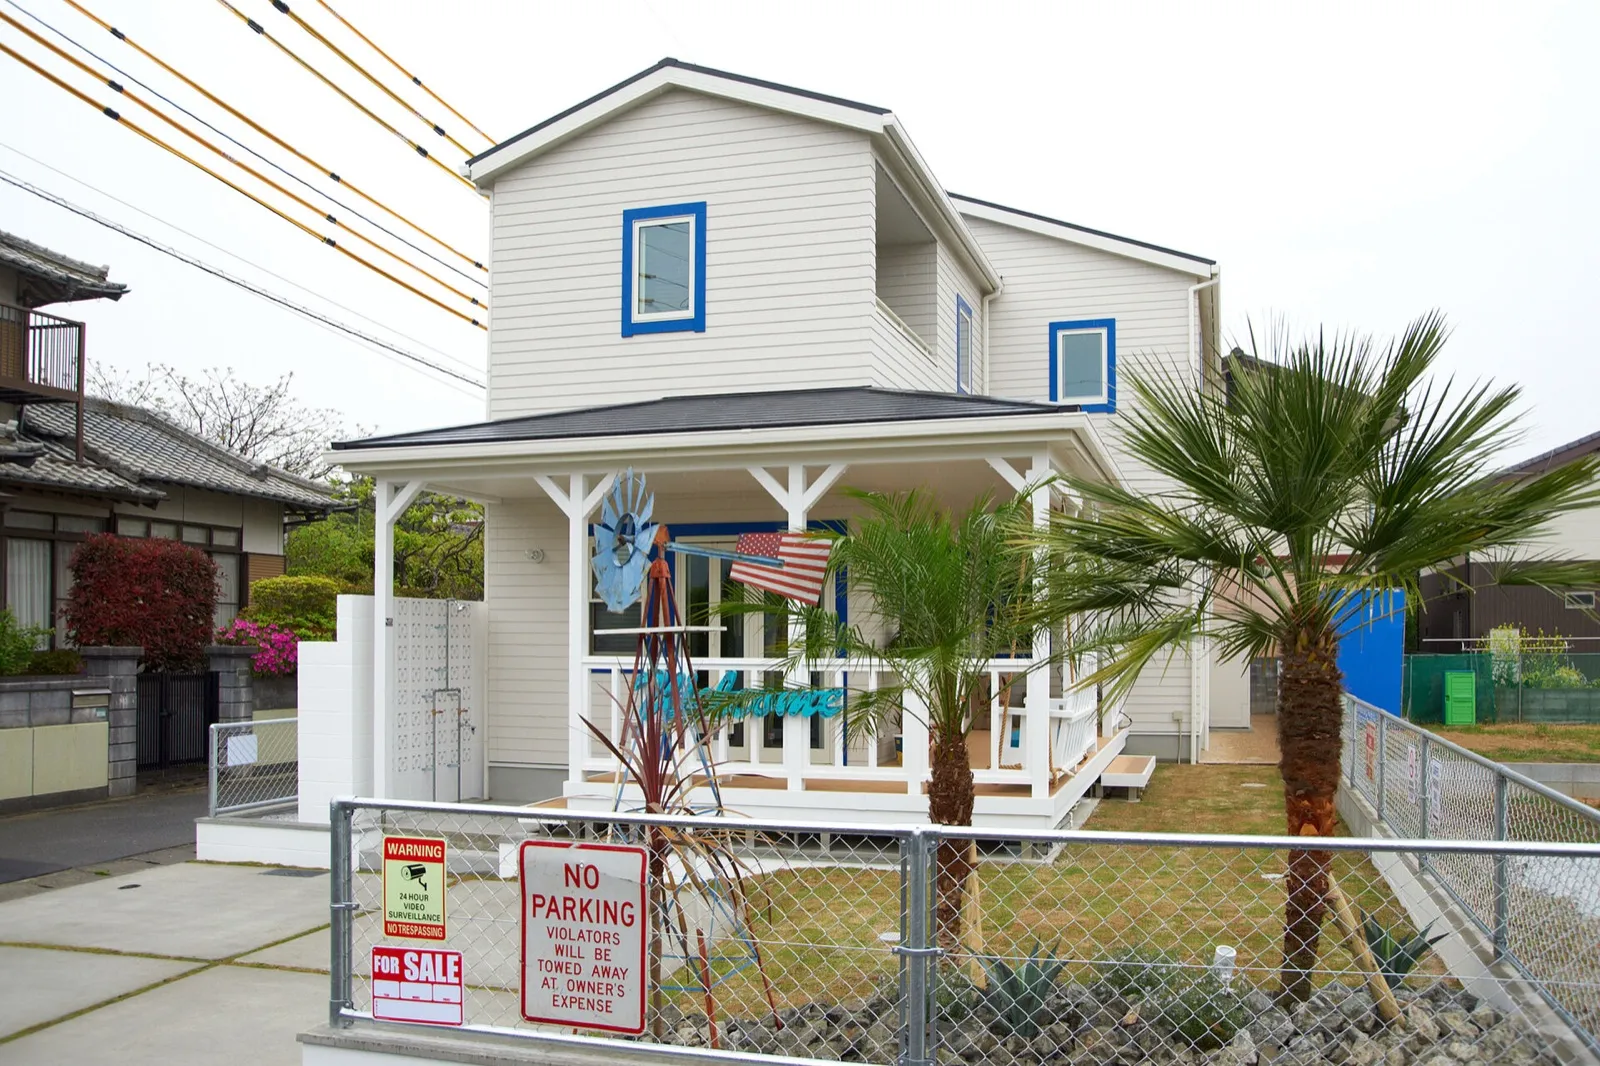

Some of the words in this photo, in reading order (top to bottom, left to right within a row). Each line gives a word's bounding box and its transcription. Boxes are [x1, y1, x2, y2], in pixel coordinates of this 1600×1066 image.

[634, 670, 843, 721] Wlome
[387, 842, 442, 858] WARNING
[564, 863, 599, 890] NO
[403, 903, 425, 911] VIDEO
[408, 893, 429, 902] HOUR
[388, 910, 441, 922] SURVEILLANCE
[532, 893, 635, 928] PARKING
[387, 923, 398, 934] NO
[398, 924, 443, 938] TRESPASSING
[546, 925, 621, 945] VIOLATORS
[554, 943, 585, 959] WILL
[594, 947, 612, 962] BE
[374, 955, 400, 974] FOR
[403, 951, 460, 984] SALE
[537, 959, 582, 976] TOWED
[591, 964, 629, 980] AWAY
[541, 976, 557, 990] AT
[566, 979, 625, 998] OWNER'S
[552, 994, 613, 1013] EXPENSE
